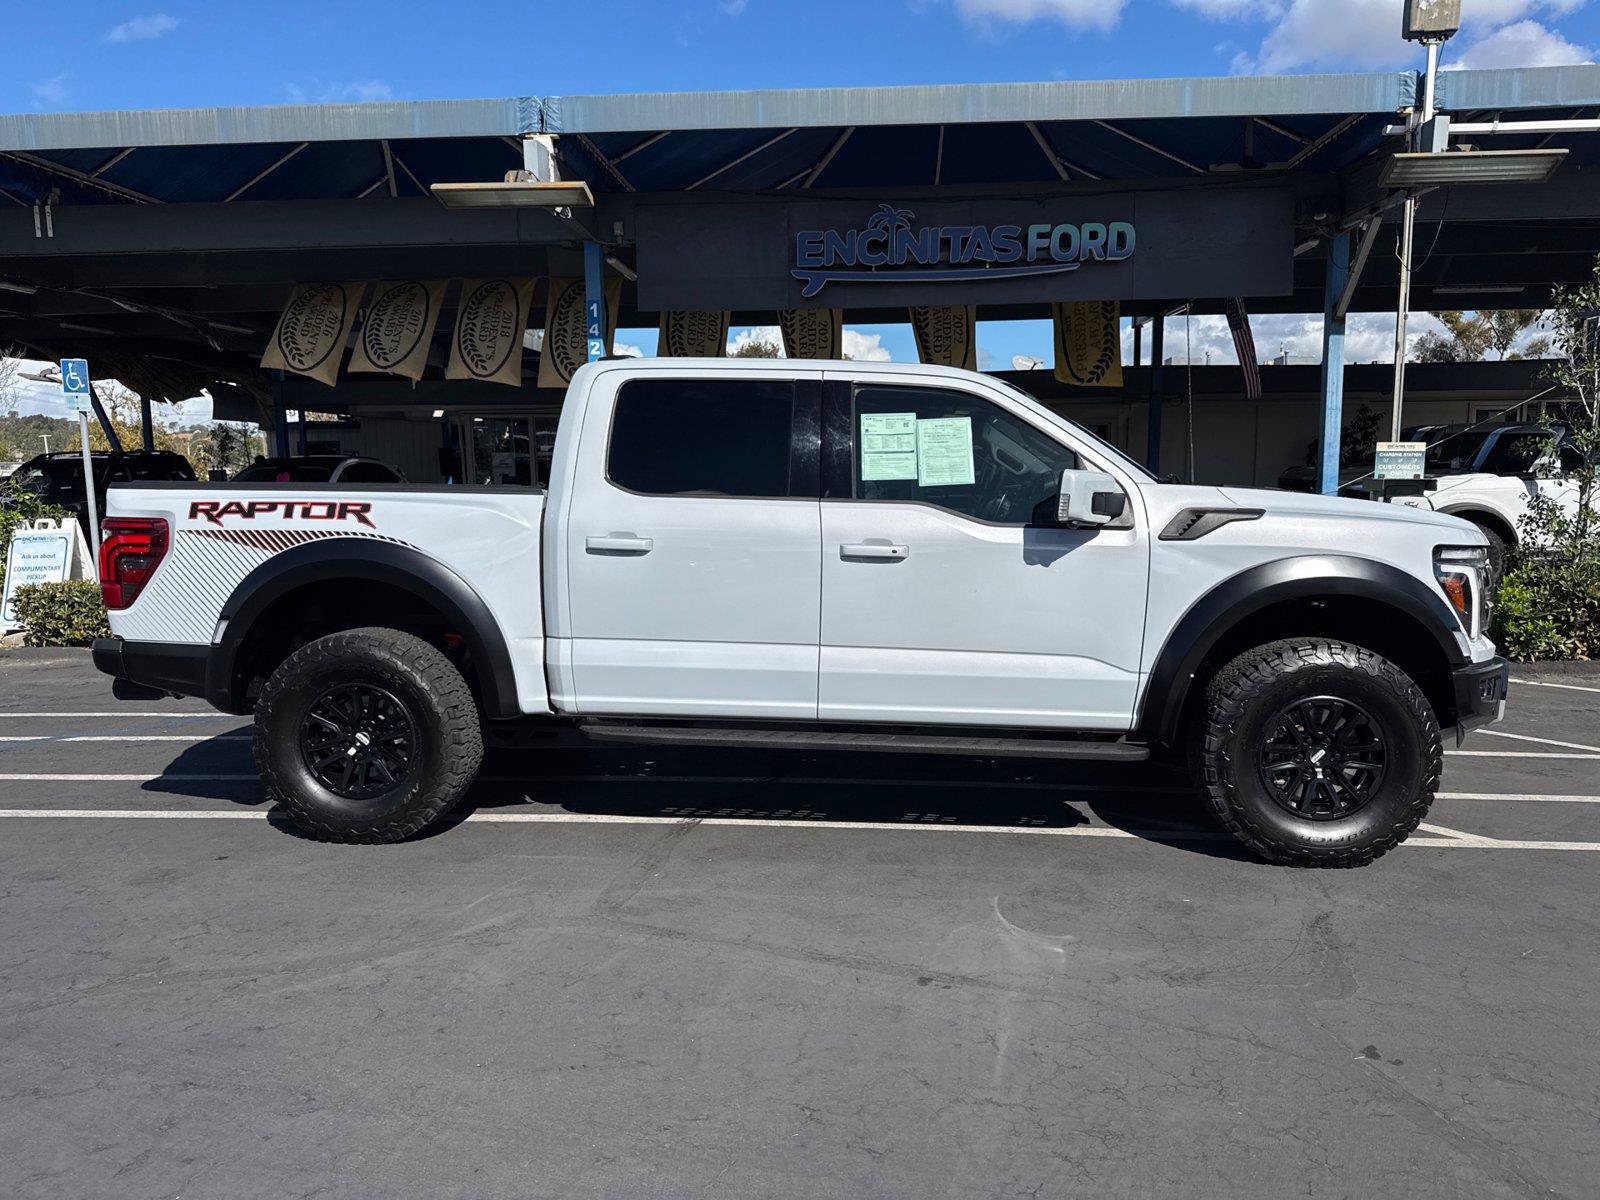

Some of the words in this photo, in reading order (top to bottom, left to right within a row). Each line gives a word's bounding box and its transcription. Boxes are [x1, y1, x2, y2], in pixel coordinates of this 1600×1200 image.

[796, 221, 1022, 267] ENCINITAS
[1027, 221, 1136, 261] FORD
[323, 310, 339, 338] 2016
[406, 309, 422, 335] 2017
[479, 305, 492, 342] AWARD
[500, 310, 514, 338] 2018
[707, 312, 719, 341] 2020
[818, 320, 829, 350] 2021
[953, 314, 963, 343] 2022
[188, 501, 377, 530] RAPTOR
[13, 565, 62, 573] COMPLIMENTARY
